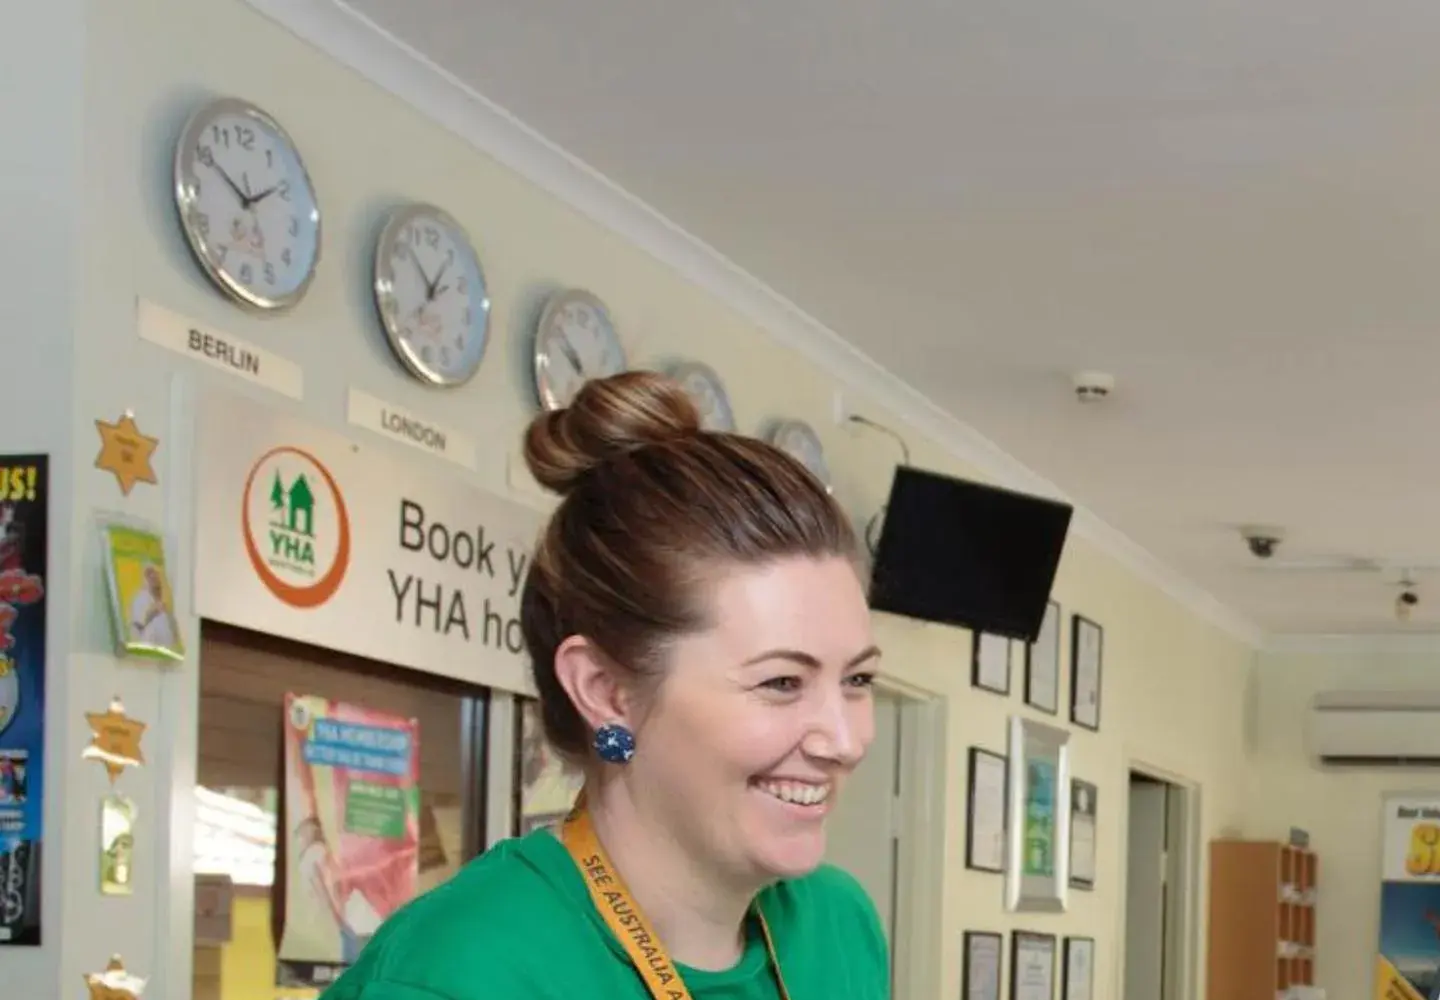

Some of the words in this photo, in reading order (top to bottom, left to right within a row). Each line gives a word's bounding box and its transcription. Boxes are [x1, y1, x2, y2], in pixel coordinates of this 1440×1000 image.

[188, 328, 260, 376] BERLIN
[380, 408, 448, 451] LONDON
[269, 529, 315, 566] YHA
[400, 498, 495, 578] Book
[508, 547, 526, 597] y
[387, 567, 470, 642] YHA
[482, 598, 525, 653] ho
[583, 854, 613, 888] SEE
[603, 890, 675, 986] AUSTRALIA
